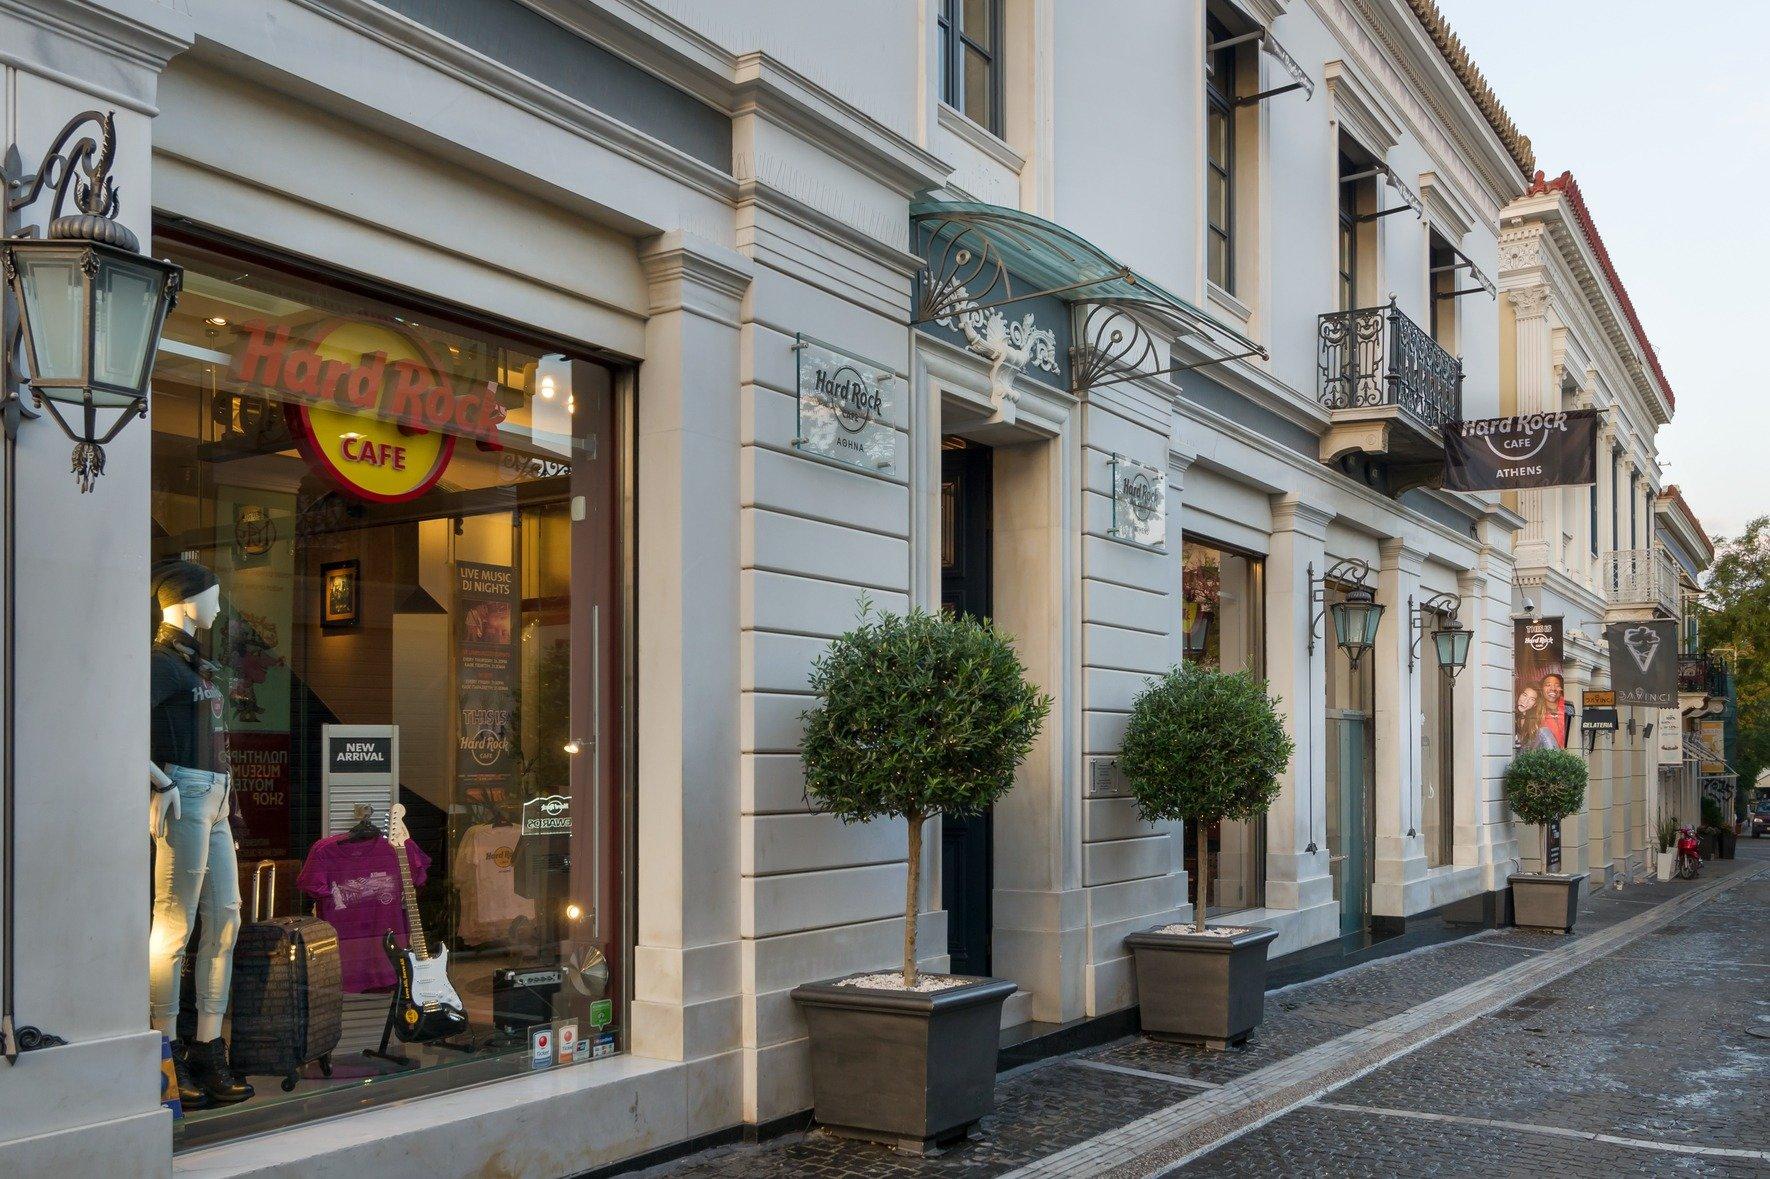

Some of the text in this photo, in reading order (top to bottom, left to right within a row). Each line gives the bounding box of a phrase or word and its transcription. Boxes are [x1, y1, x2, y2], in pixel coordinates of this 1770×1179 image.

[236, 318, 508, 452] Hard Rock
[815, 369, 882, 417] Hard Rock
[1461, 411, 1567, 437] Hard Rock
[1503, 438, 1531, 449] CAFE
[340, 436, 407, 472] CAFE
[1495, 465, 1543, 479] ATHENS
[1123, 478, 1142, 499] Hard
[460, 567, 512, 583] LIVE MUSIC
[462, 580, 510, 595] DJ NIGHTS
[463, 709, 508, 726] THIS IS
[346, 742, 376, 752] NEW
[460, 736, 510, 755] Hard Rock
[336, 751, 385, 762] ARRIVAL
